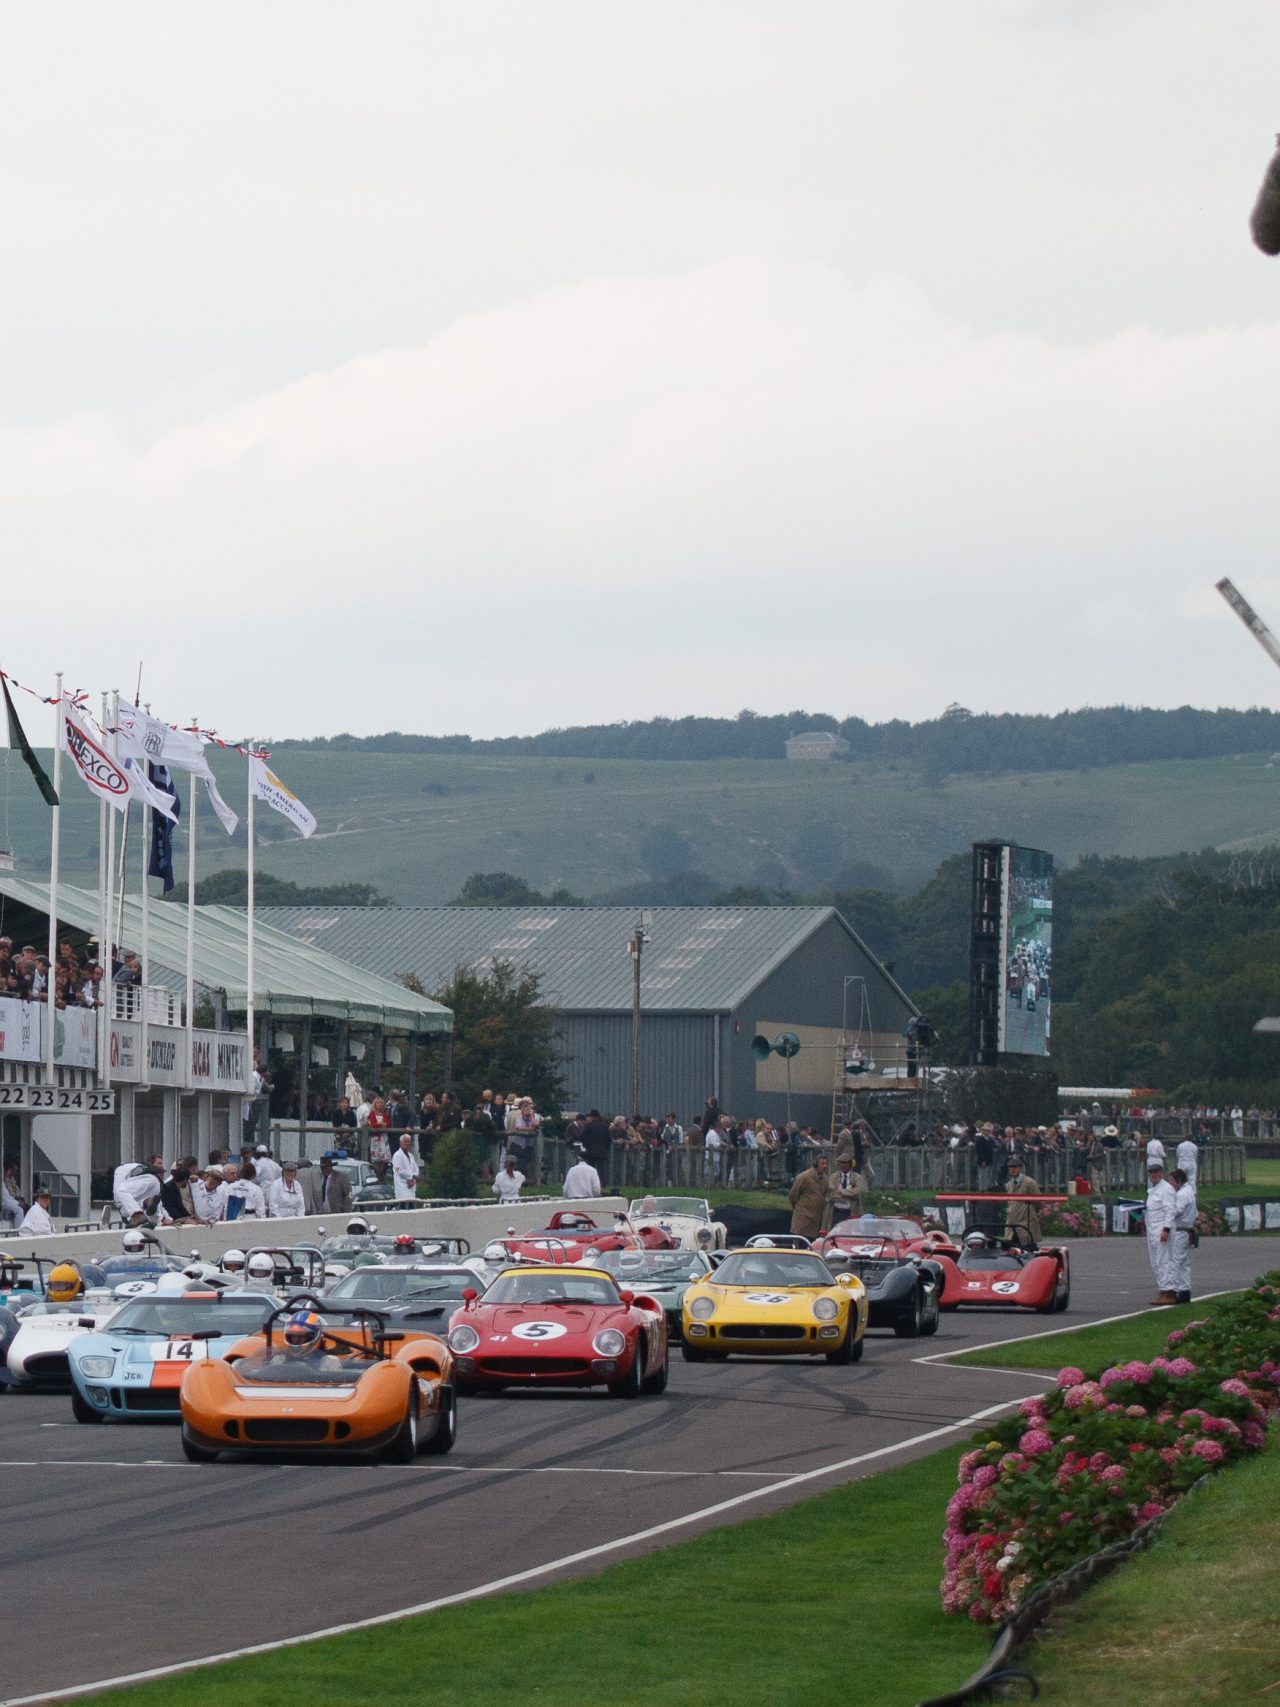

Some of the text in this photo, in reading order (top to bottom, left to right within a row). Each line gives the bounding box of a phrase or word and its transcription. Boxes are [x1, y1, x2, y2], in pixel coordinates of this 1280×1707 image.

[150, 1040, 176, 1071] DUNLOP
[217, 1043, 244, 1081] MINTEX
[0, 1088, 24, 1104] 22
[31, 1090, 54, 1106] 23
[59, 1092, 82, 1108] 24
[88, 1095, 111, 1110] 25
[128, 1282, 145, 1293] 3
[996, 1282, 1015, 1293] 2
[745, 1293, 789, 1304] 26
[522, 1323, 555, 1338] 5
[166, 1342, 193, 1360] 14
